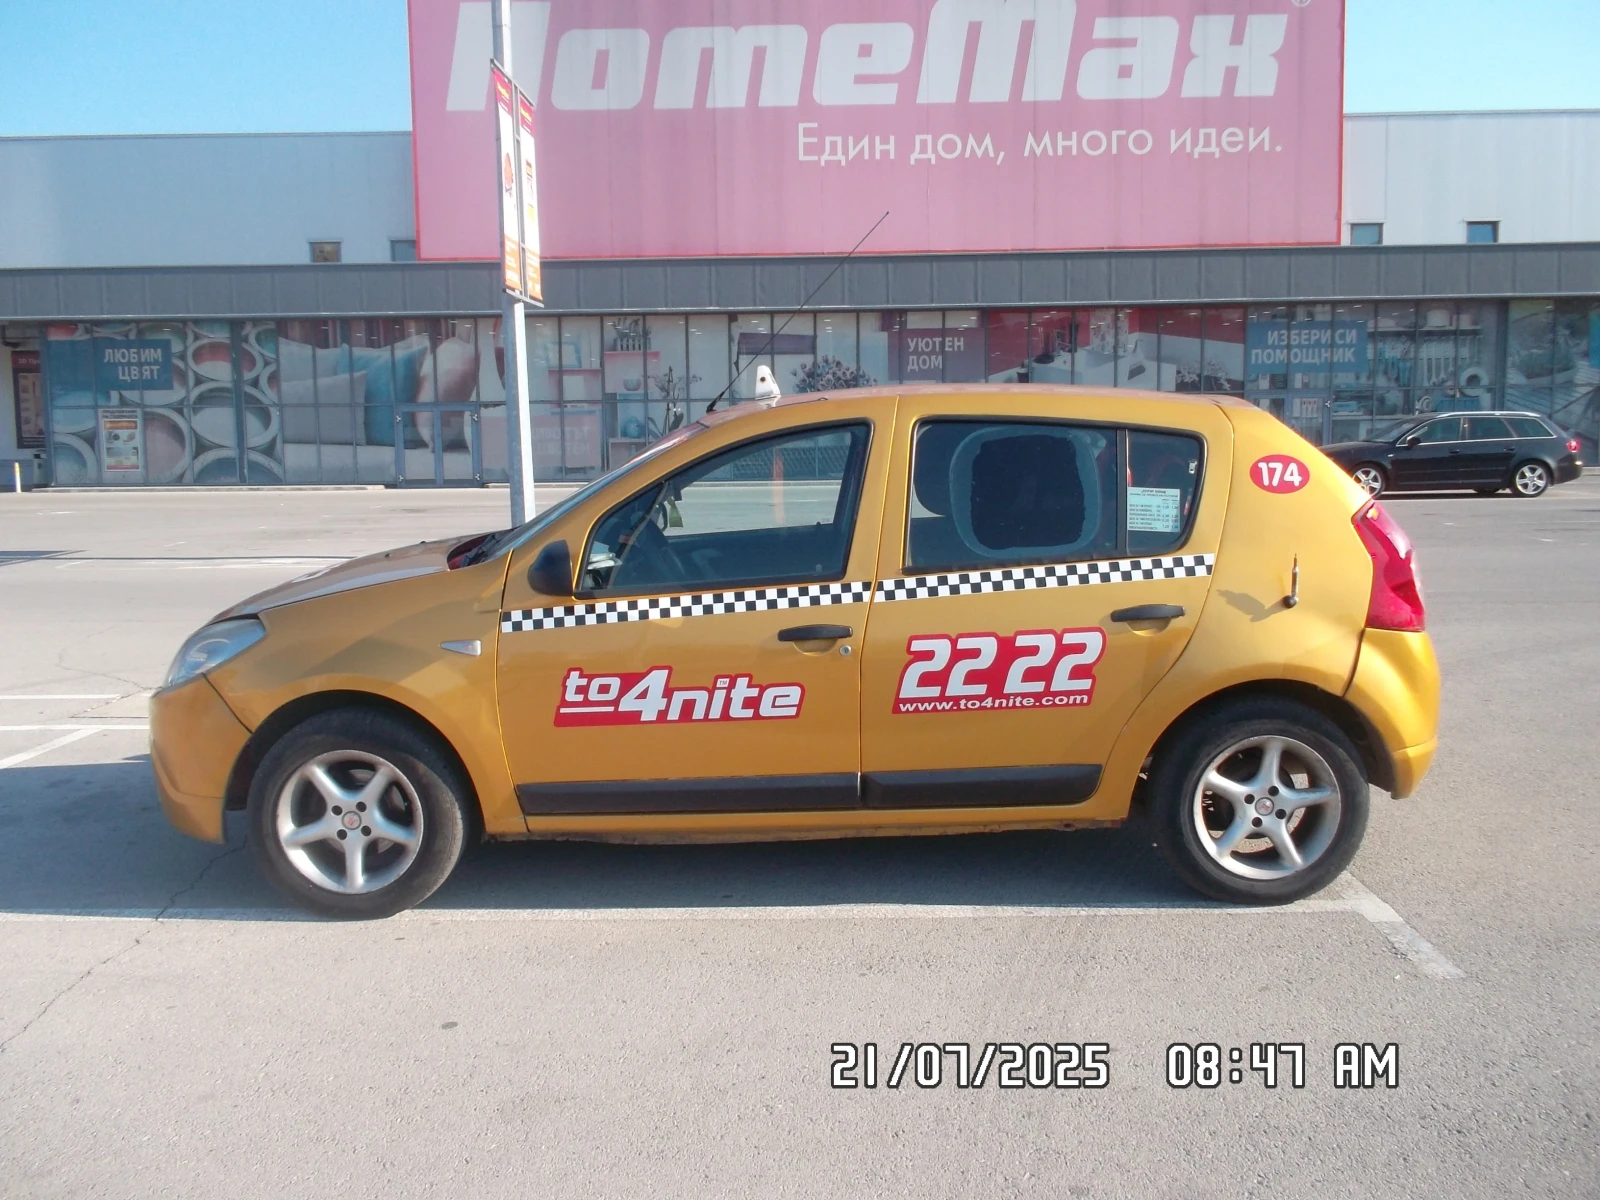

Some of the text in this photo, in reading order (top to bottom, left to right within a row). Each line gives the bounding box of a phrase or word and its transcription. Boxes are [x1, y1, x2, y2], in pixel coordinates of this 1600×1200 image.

[446, 0, 1288, 111] HomeMax
[797, 122, 1283, 166] Един дом, много идеи.
[907, 337, 964, 353] УЮТЕН
[1267, 327, 1357, 346] ИЗБЕРИ СИ
[103, 348, 163, 363] ЛЮБИМ
[907, 355, 943, 373] ДОМ
[1250, 347, 1355, 366] ПОМОЩНИК
[117, 365, 160, 382] ЦВЯТ
[1257, 461, 1302, 487] 174
[560, 669, 801, 721] to4nite
[898, 694, 1088, 712] www.to4nite.com
